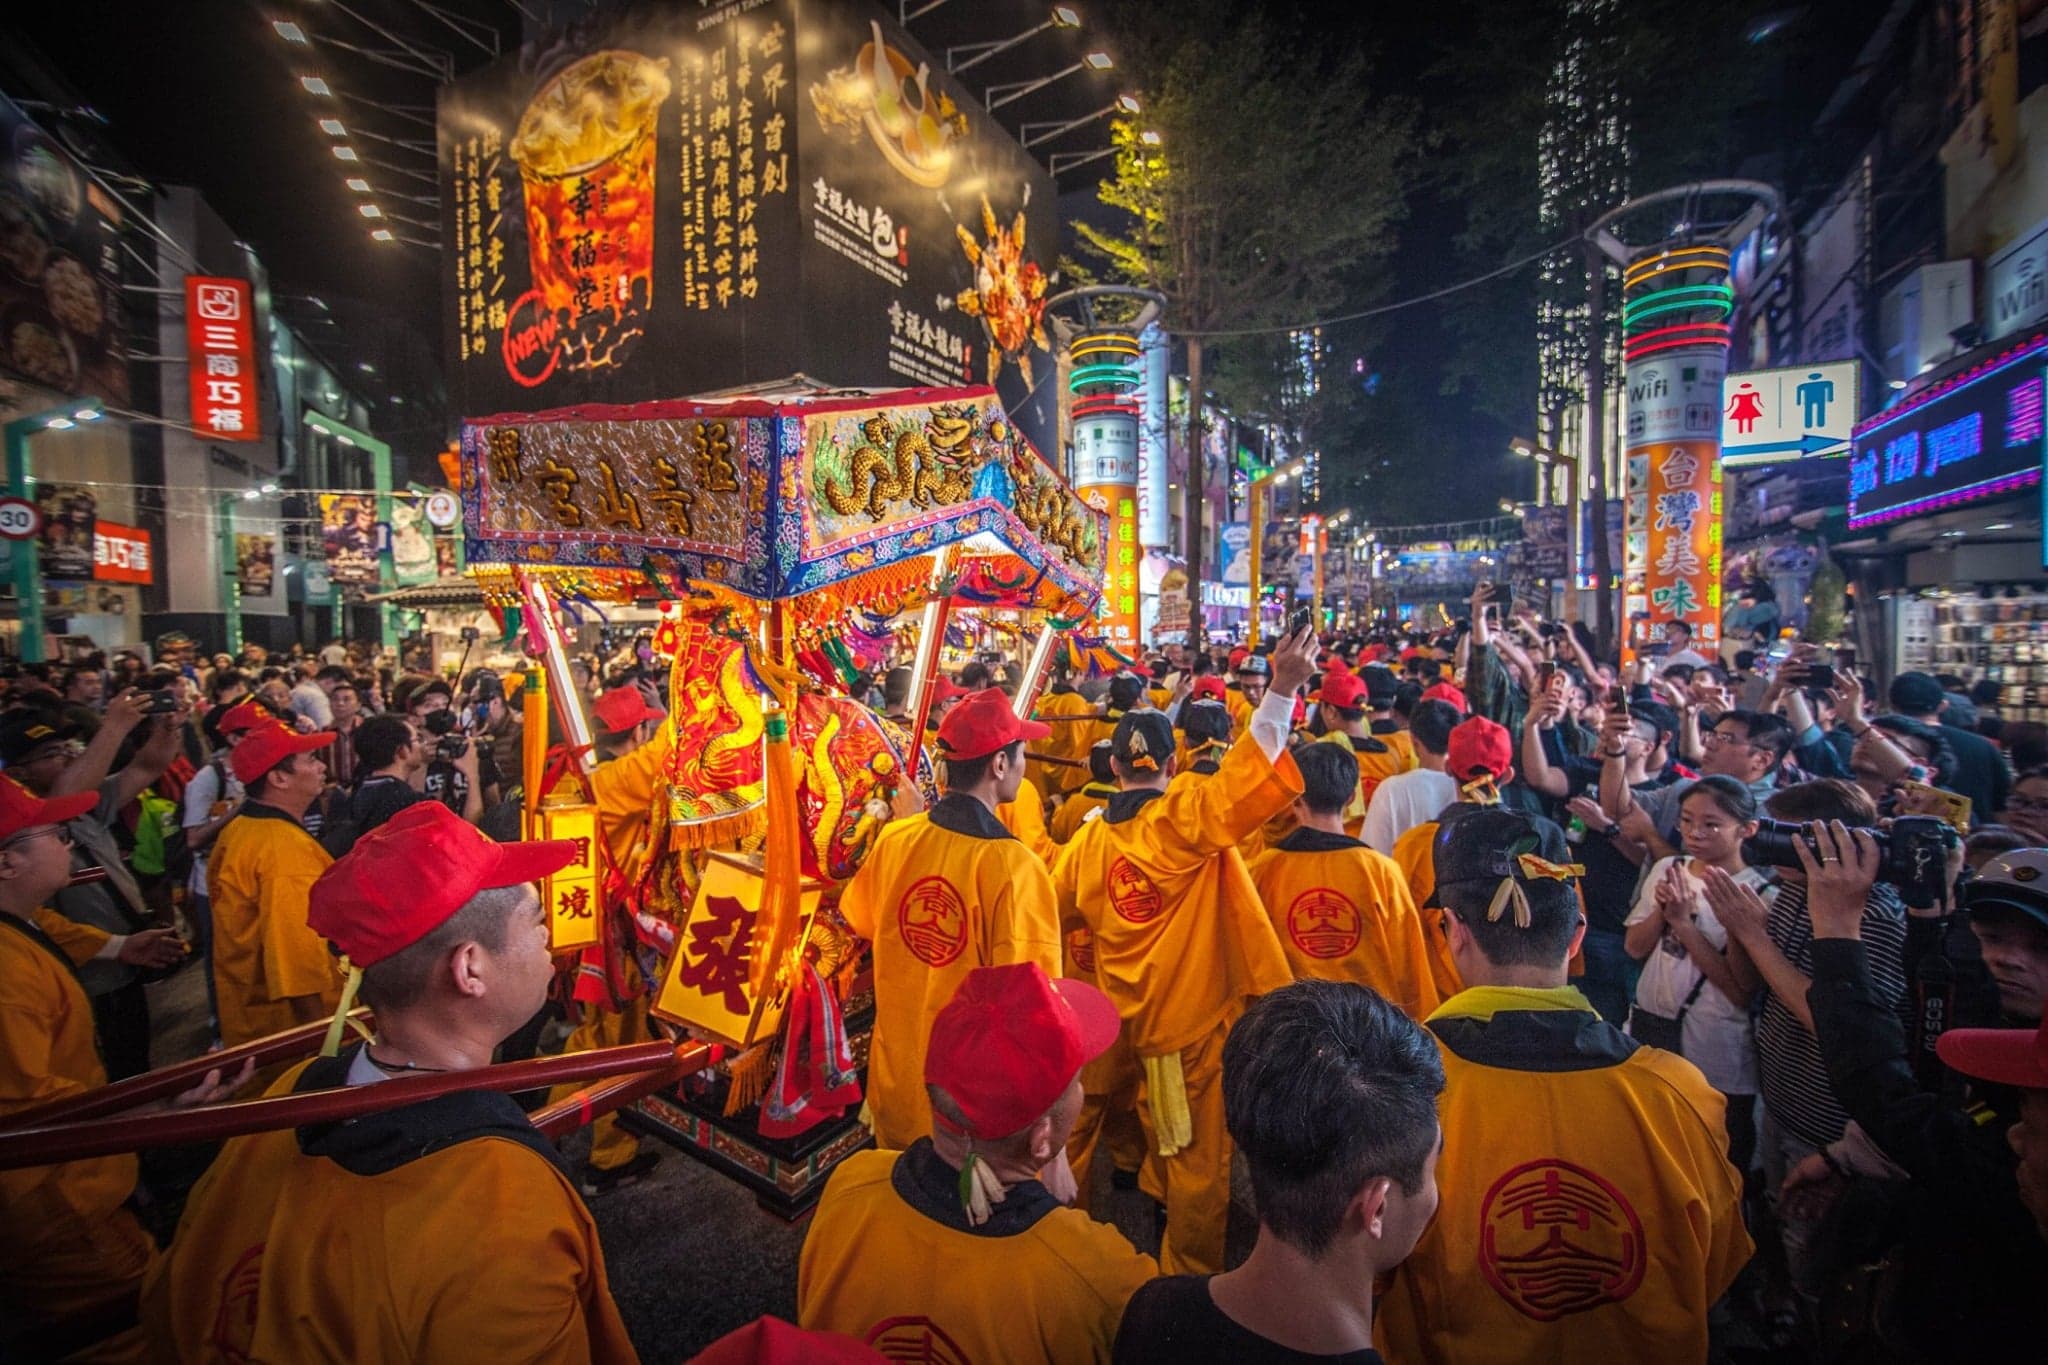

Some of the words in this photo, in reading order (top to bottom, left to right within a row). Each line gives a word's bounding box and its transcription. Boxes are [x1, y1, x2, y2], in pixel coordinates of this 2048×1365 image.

[758, 21, 788, 197] 世界首創
[680, 144, 691, 193] unique
[694, 186, 706, 235] luxury
[569, 177, 599, 321] 幸福堂
[683, 223, 694, 250] the
[694, 243, 709, 273] gold
[696, 282, 710, 310] foil
[510, 313, 557, 364] NEW
[203, 325, 244, 432] 三商巧福
[0, 511, 29, 528] 30
[1654, 447, 1702, 619] 台灣美味
[1925, 998, 1943, 1033] EOS
